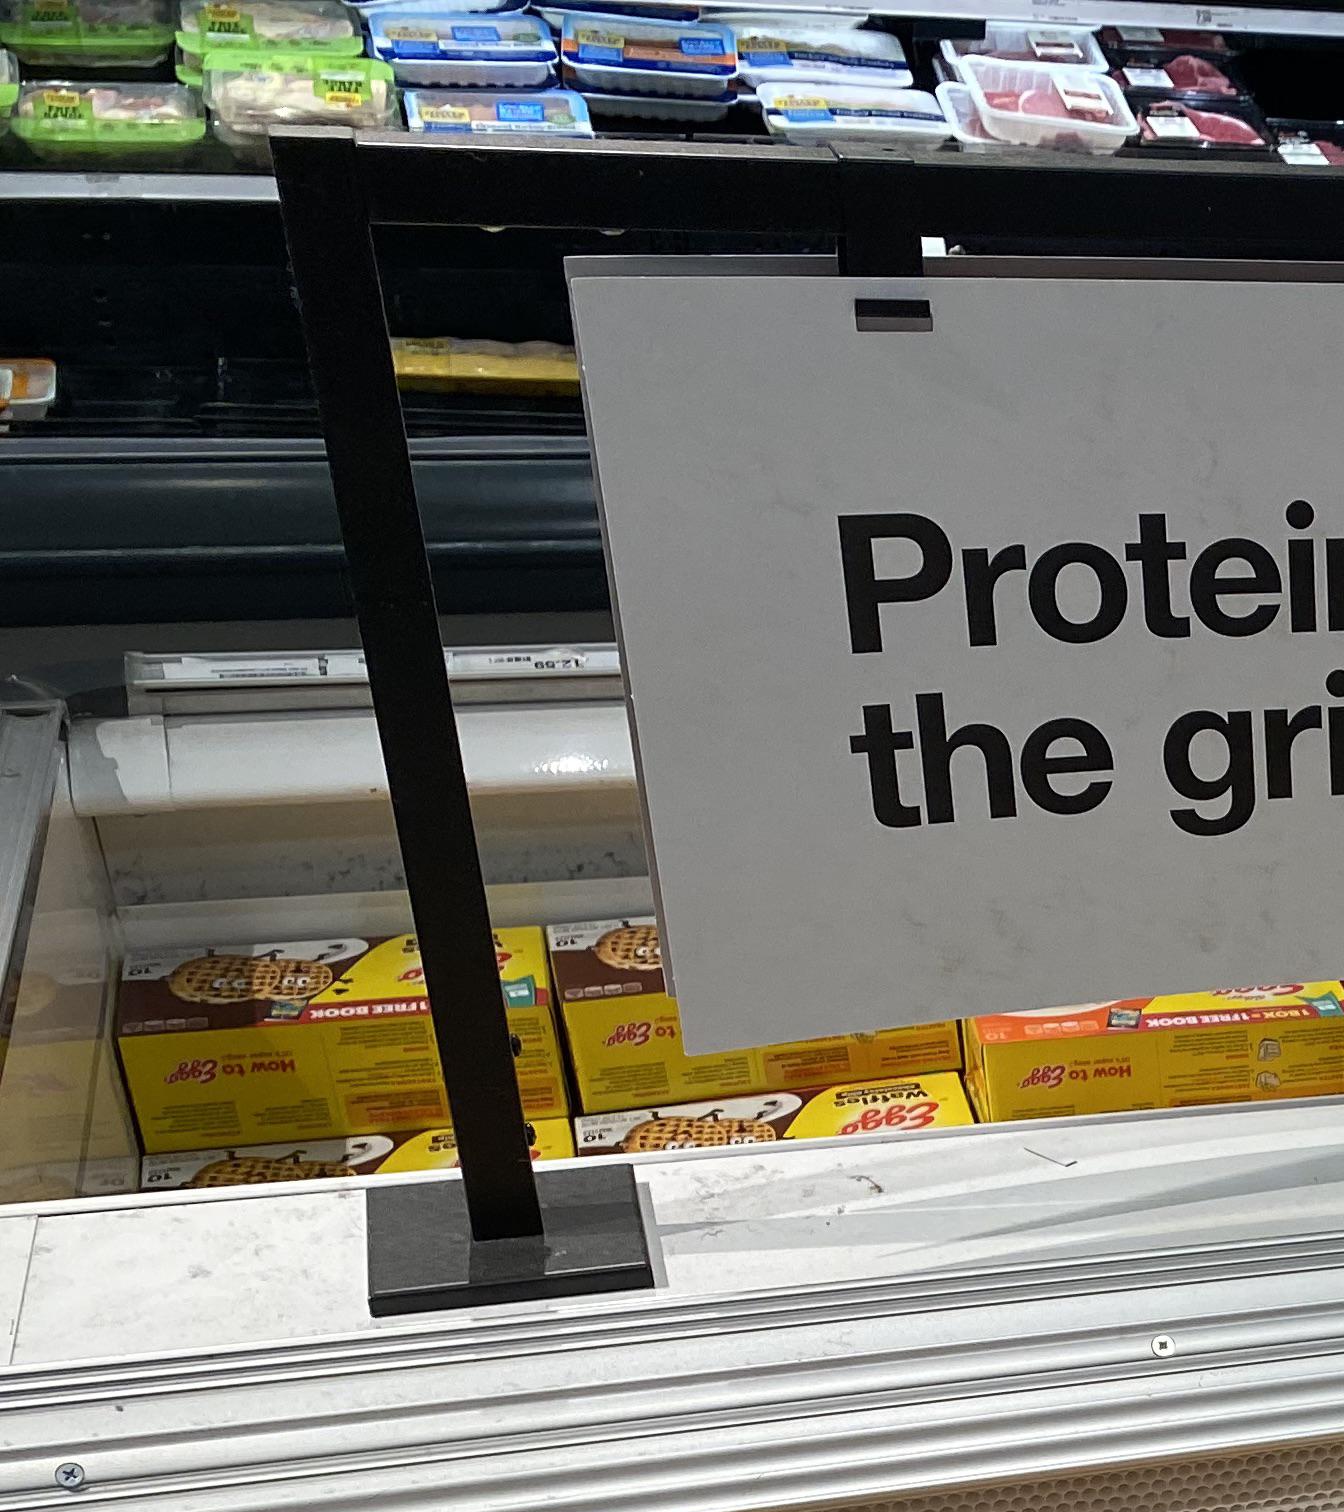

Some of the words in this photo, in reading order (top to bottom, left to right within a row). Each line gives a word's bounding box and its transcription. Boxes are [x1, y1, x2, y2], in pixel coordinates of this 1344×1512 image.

[850, 691, 1114, 829] the
[309, 1004, 370, 1018] BOOK
[1145, 1014, 1198, 1029] BOOK
[602, 1022, 651, 1047] Eggo
[165, 1058, 219, 1084] Eggo
[222, 1062, 245, 1077] to
[251, 1057, 296, 1075] How
[1091, 1063, 1132, 1080] How
[1017, 1064, 1067, 1090] Eggo
[1068, 1068, 1088, 1084] to
[838, 1102, 940, 1135] Eggo
